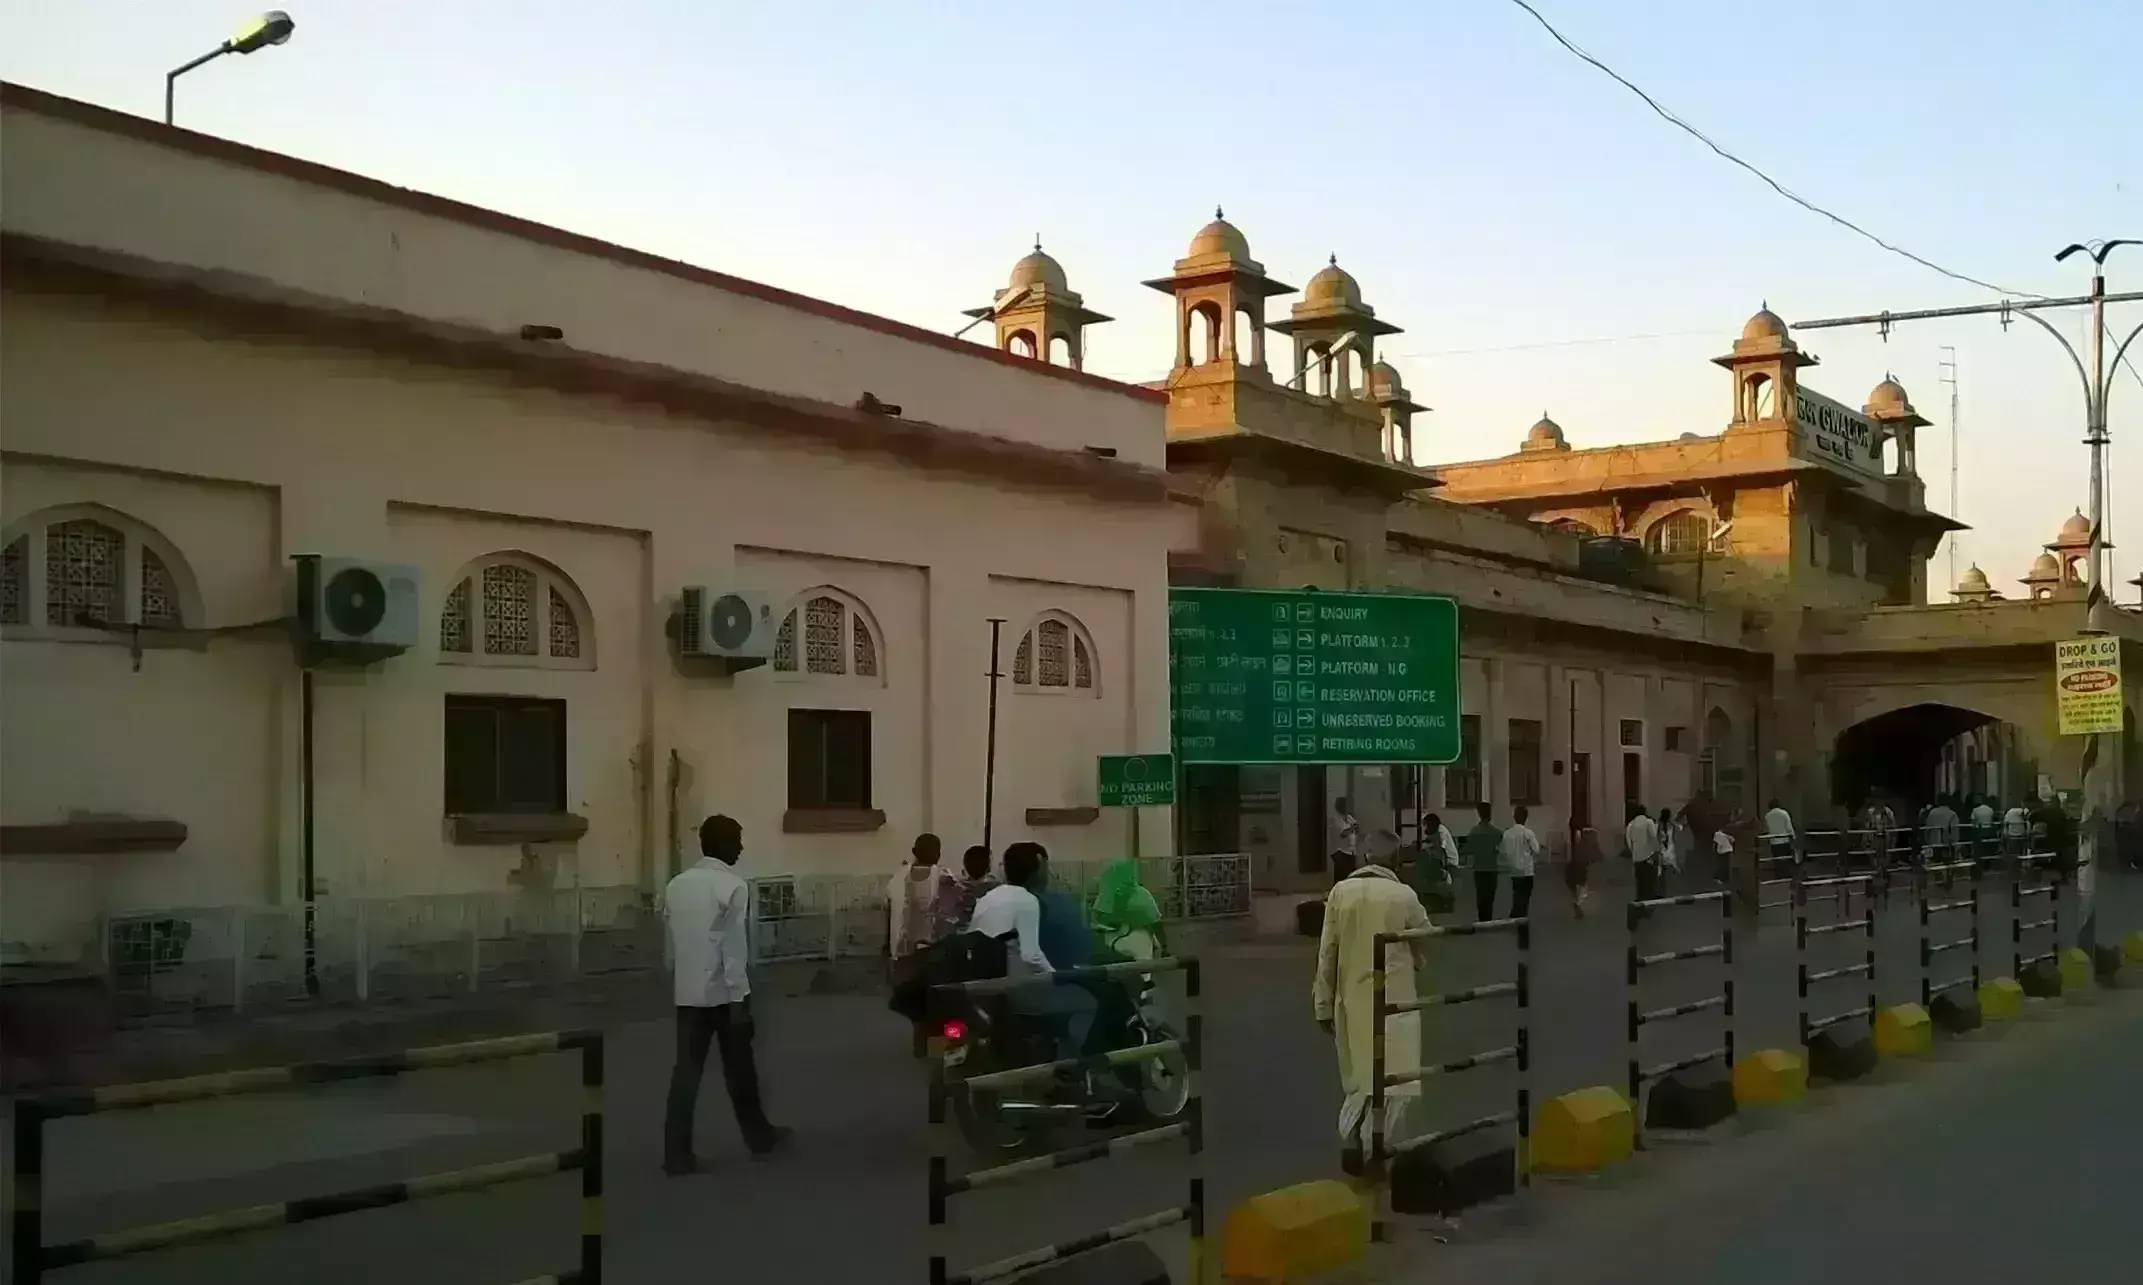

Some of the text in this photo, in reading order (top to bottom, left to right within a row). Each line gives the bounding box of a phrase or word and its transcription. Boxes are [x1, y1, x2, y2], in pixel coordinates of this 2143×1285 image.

[1320, 607, 1369, 620] ENQUIRY
[1320, 634, 1379, 648] PLATFORM
[2059, 642, 2117, 658] DROP & GO
[1320, 661, 1379, 676] PLATFORM
[1321, 689, 1437, 703] RESERVATION OFFICE
[1321, 714, 1446, 729] UNRESERVED BOOKING
[1322, 738, 1416, 751] RETIRING ROOMS
[1121, 781, 1173, 793] PARKING
[1121, 794, 1153, 804] ZONE
